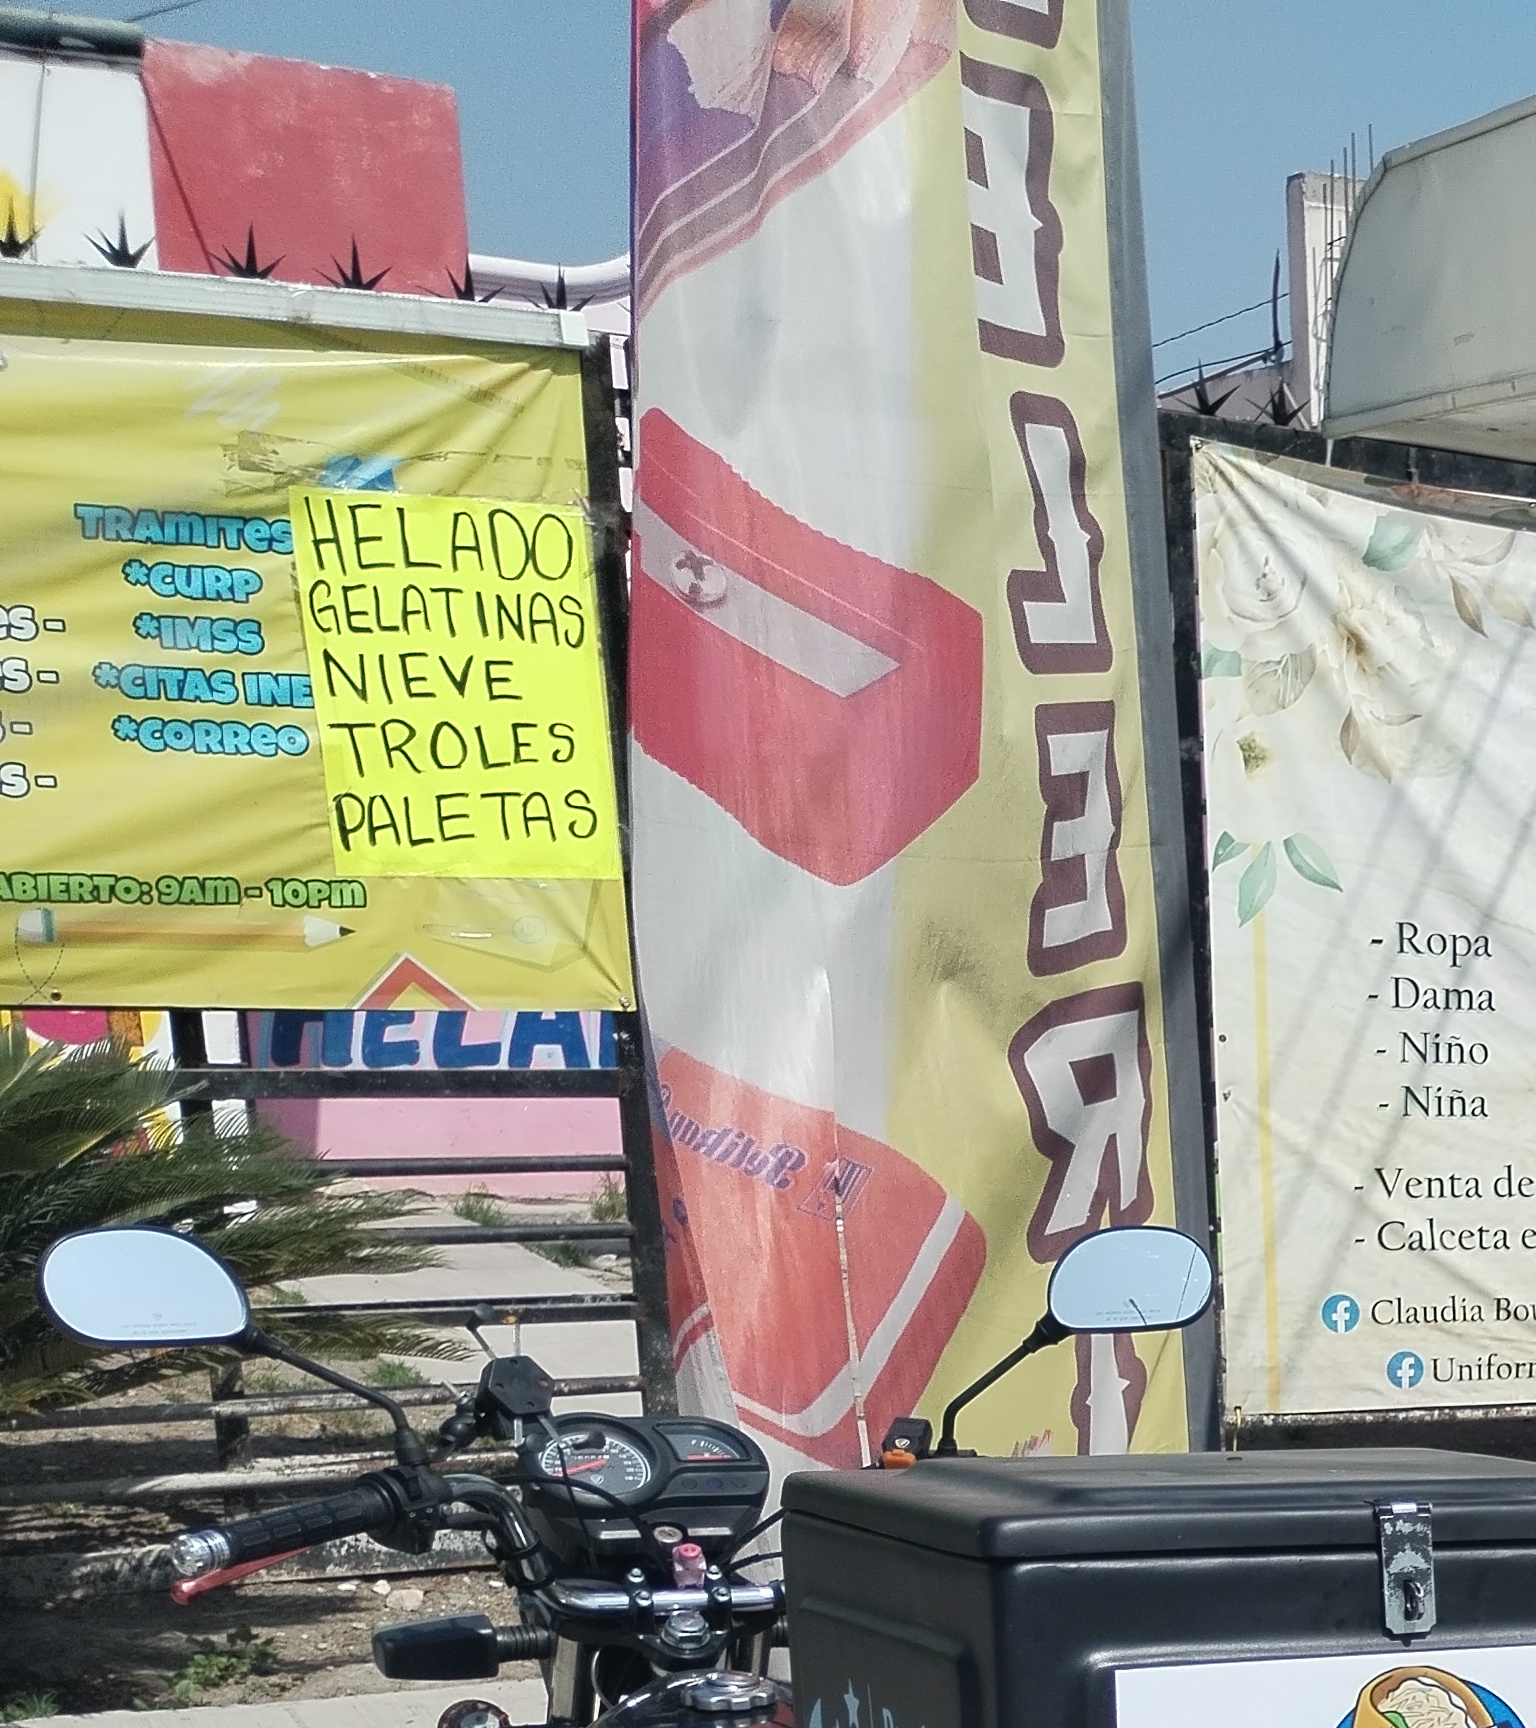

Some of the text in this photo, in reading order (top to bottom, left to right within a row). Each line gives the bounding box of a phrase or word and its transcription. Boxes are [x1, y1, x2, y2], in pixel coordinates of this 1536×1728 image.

[304, 496, 574, 580] HELADO
[308, 579, 585, 649] GELATINAS
[242, 671, 315, 709] INE
[322, 649, 523, 704] NIEVE
[327, 718, 575, 778] TROLES
[332, 789, 598, 852] PALETAS
[1396, 922, 1492, 968] Ropa
[1391, 976, 1496, 1012] Dama
[262, 1010, 617, 1068] HELA
[1399, 1032, 1489, 1065] Niño
[1401, 1085, 1489, 1118] Niña
[1375, 1168, 1483, 1198] Venta
[1494, 1164, 1534, 1197] de
[1377, 1218, 1510, 1251] Calceta
[1371, 1296, 1485, 1325] Claudia
